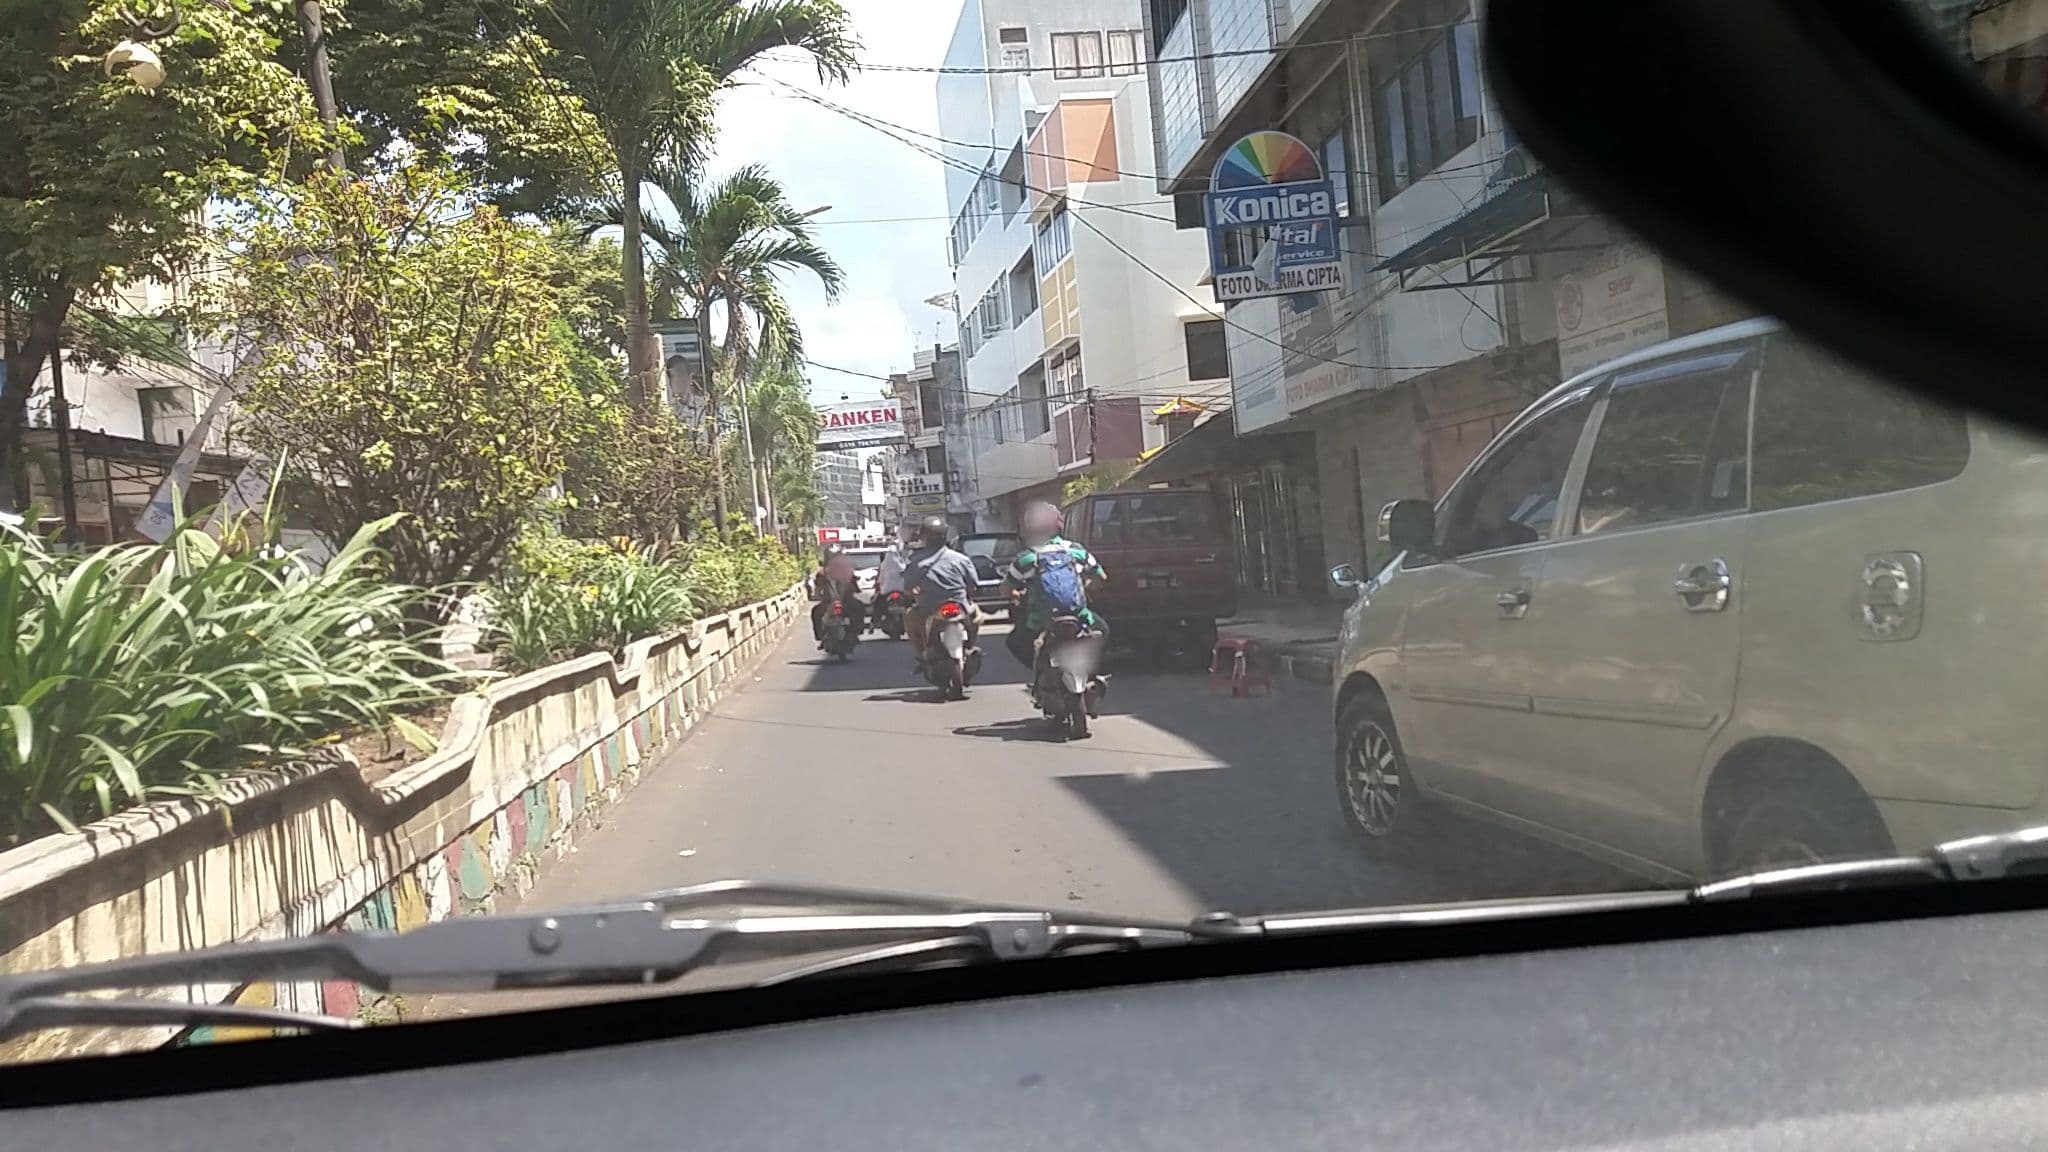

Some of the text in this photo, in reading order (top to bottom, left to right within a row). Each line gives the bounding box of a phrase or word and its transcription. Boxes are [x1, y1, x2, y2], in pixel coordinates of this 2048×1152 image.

[1214, 189, 1330, 225] Konica
[1277, 249, 1325, 261] ervice
[1221, 276, 1252, 296] FOTO
[1307, 266, 1341, 287] CIPTA
